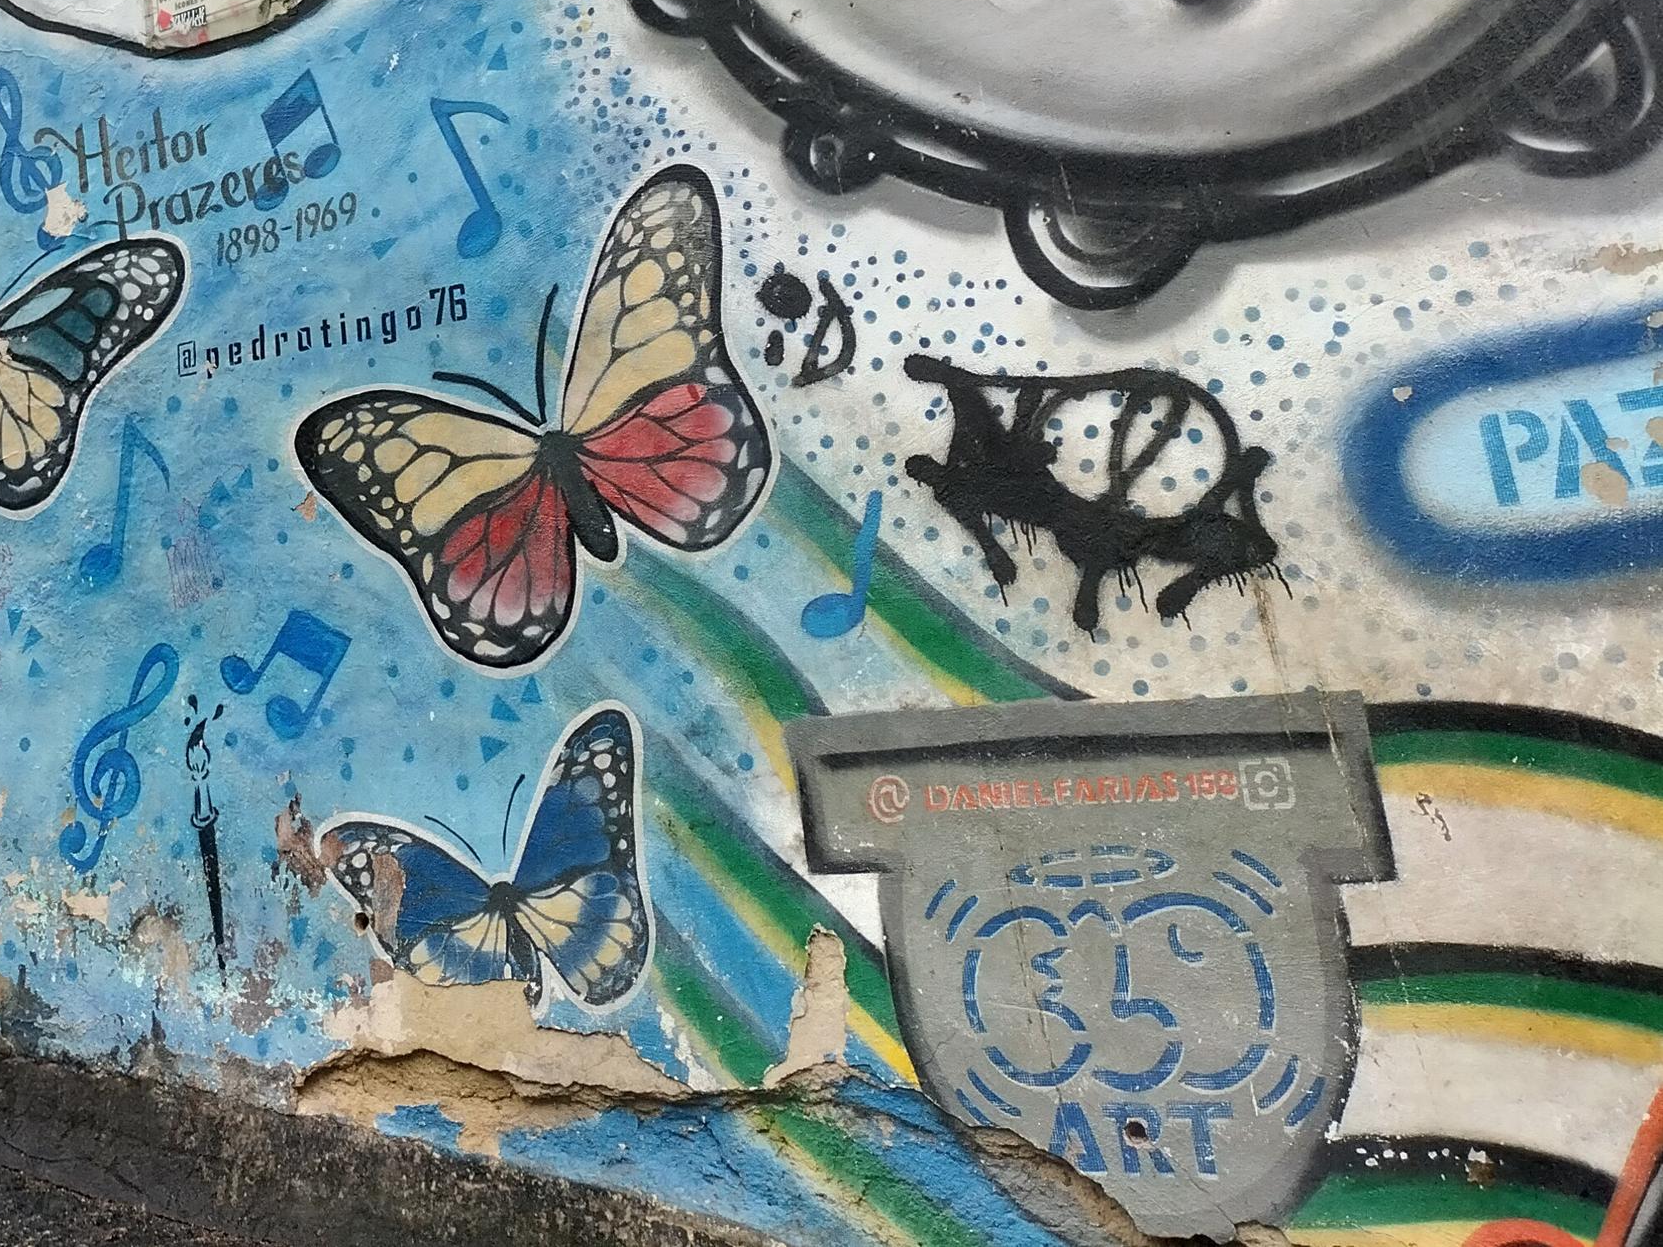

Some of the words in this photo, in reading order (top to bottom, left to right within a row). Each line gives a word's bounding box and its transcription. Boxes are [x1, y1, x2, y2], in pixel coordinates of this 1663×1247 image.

[33, 106, 211, 193] Heitor
[88, 150, 307, 241] Prazeres
[217, 191, 357, 268] 1898-1969
[176, 283, 468, 379] @pedrotingo76
[1046, 1100, 1235, 1179] ART
